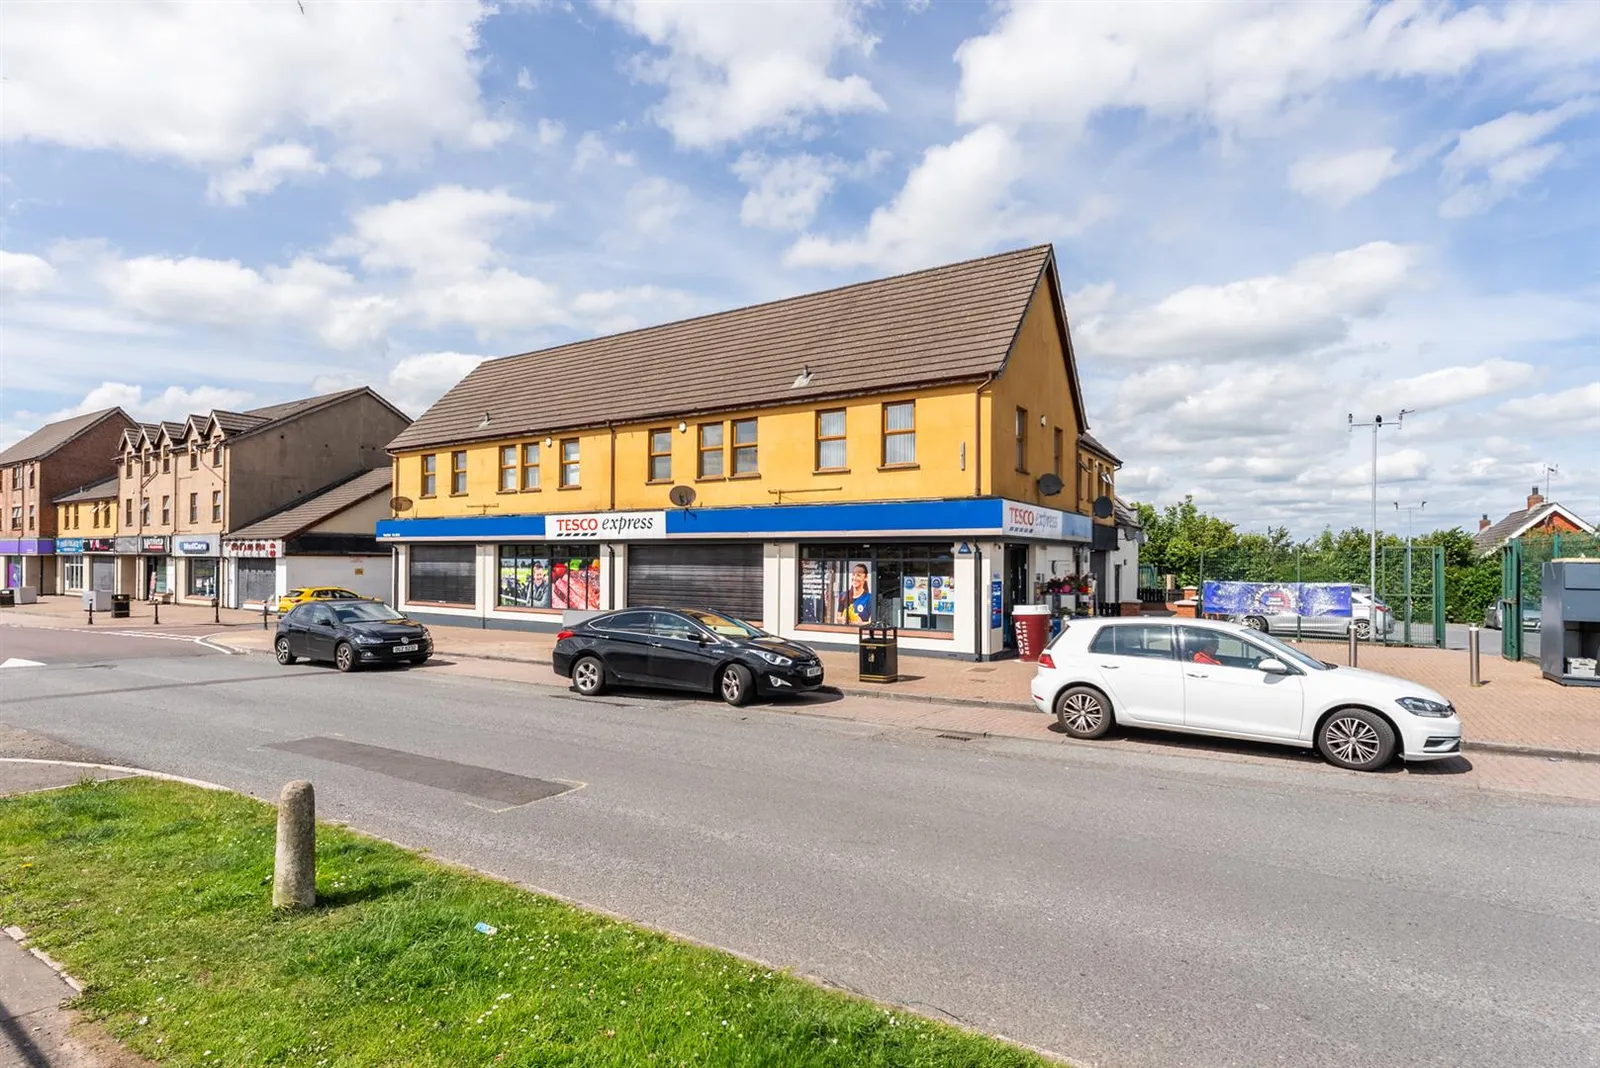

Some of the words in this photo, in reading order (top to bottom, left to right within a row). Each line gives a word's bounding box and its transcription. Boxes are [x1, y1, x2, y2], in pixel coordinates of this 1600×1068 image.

[556, 518, 598, 531] TESCO
[602, 516, 653, 534] express
[1009, 507, 1034, 526] TESCO
[1036, 513, 1058, 532] express
[1015, 621, 1024, 655] COSTA
